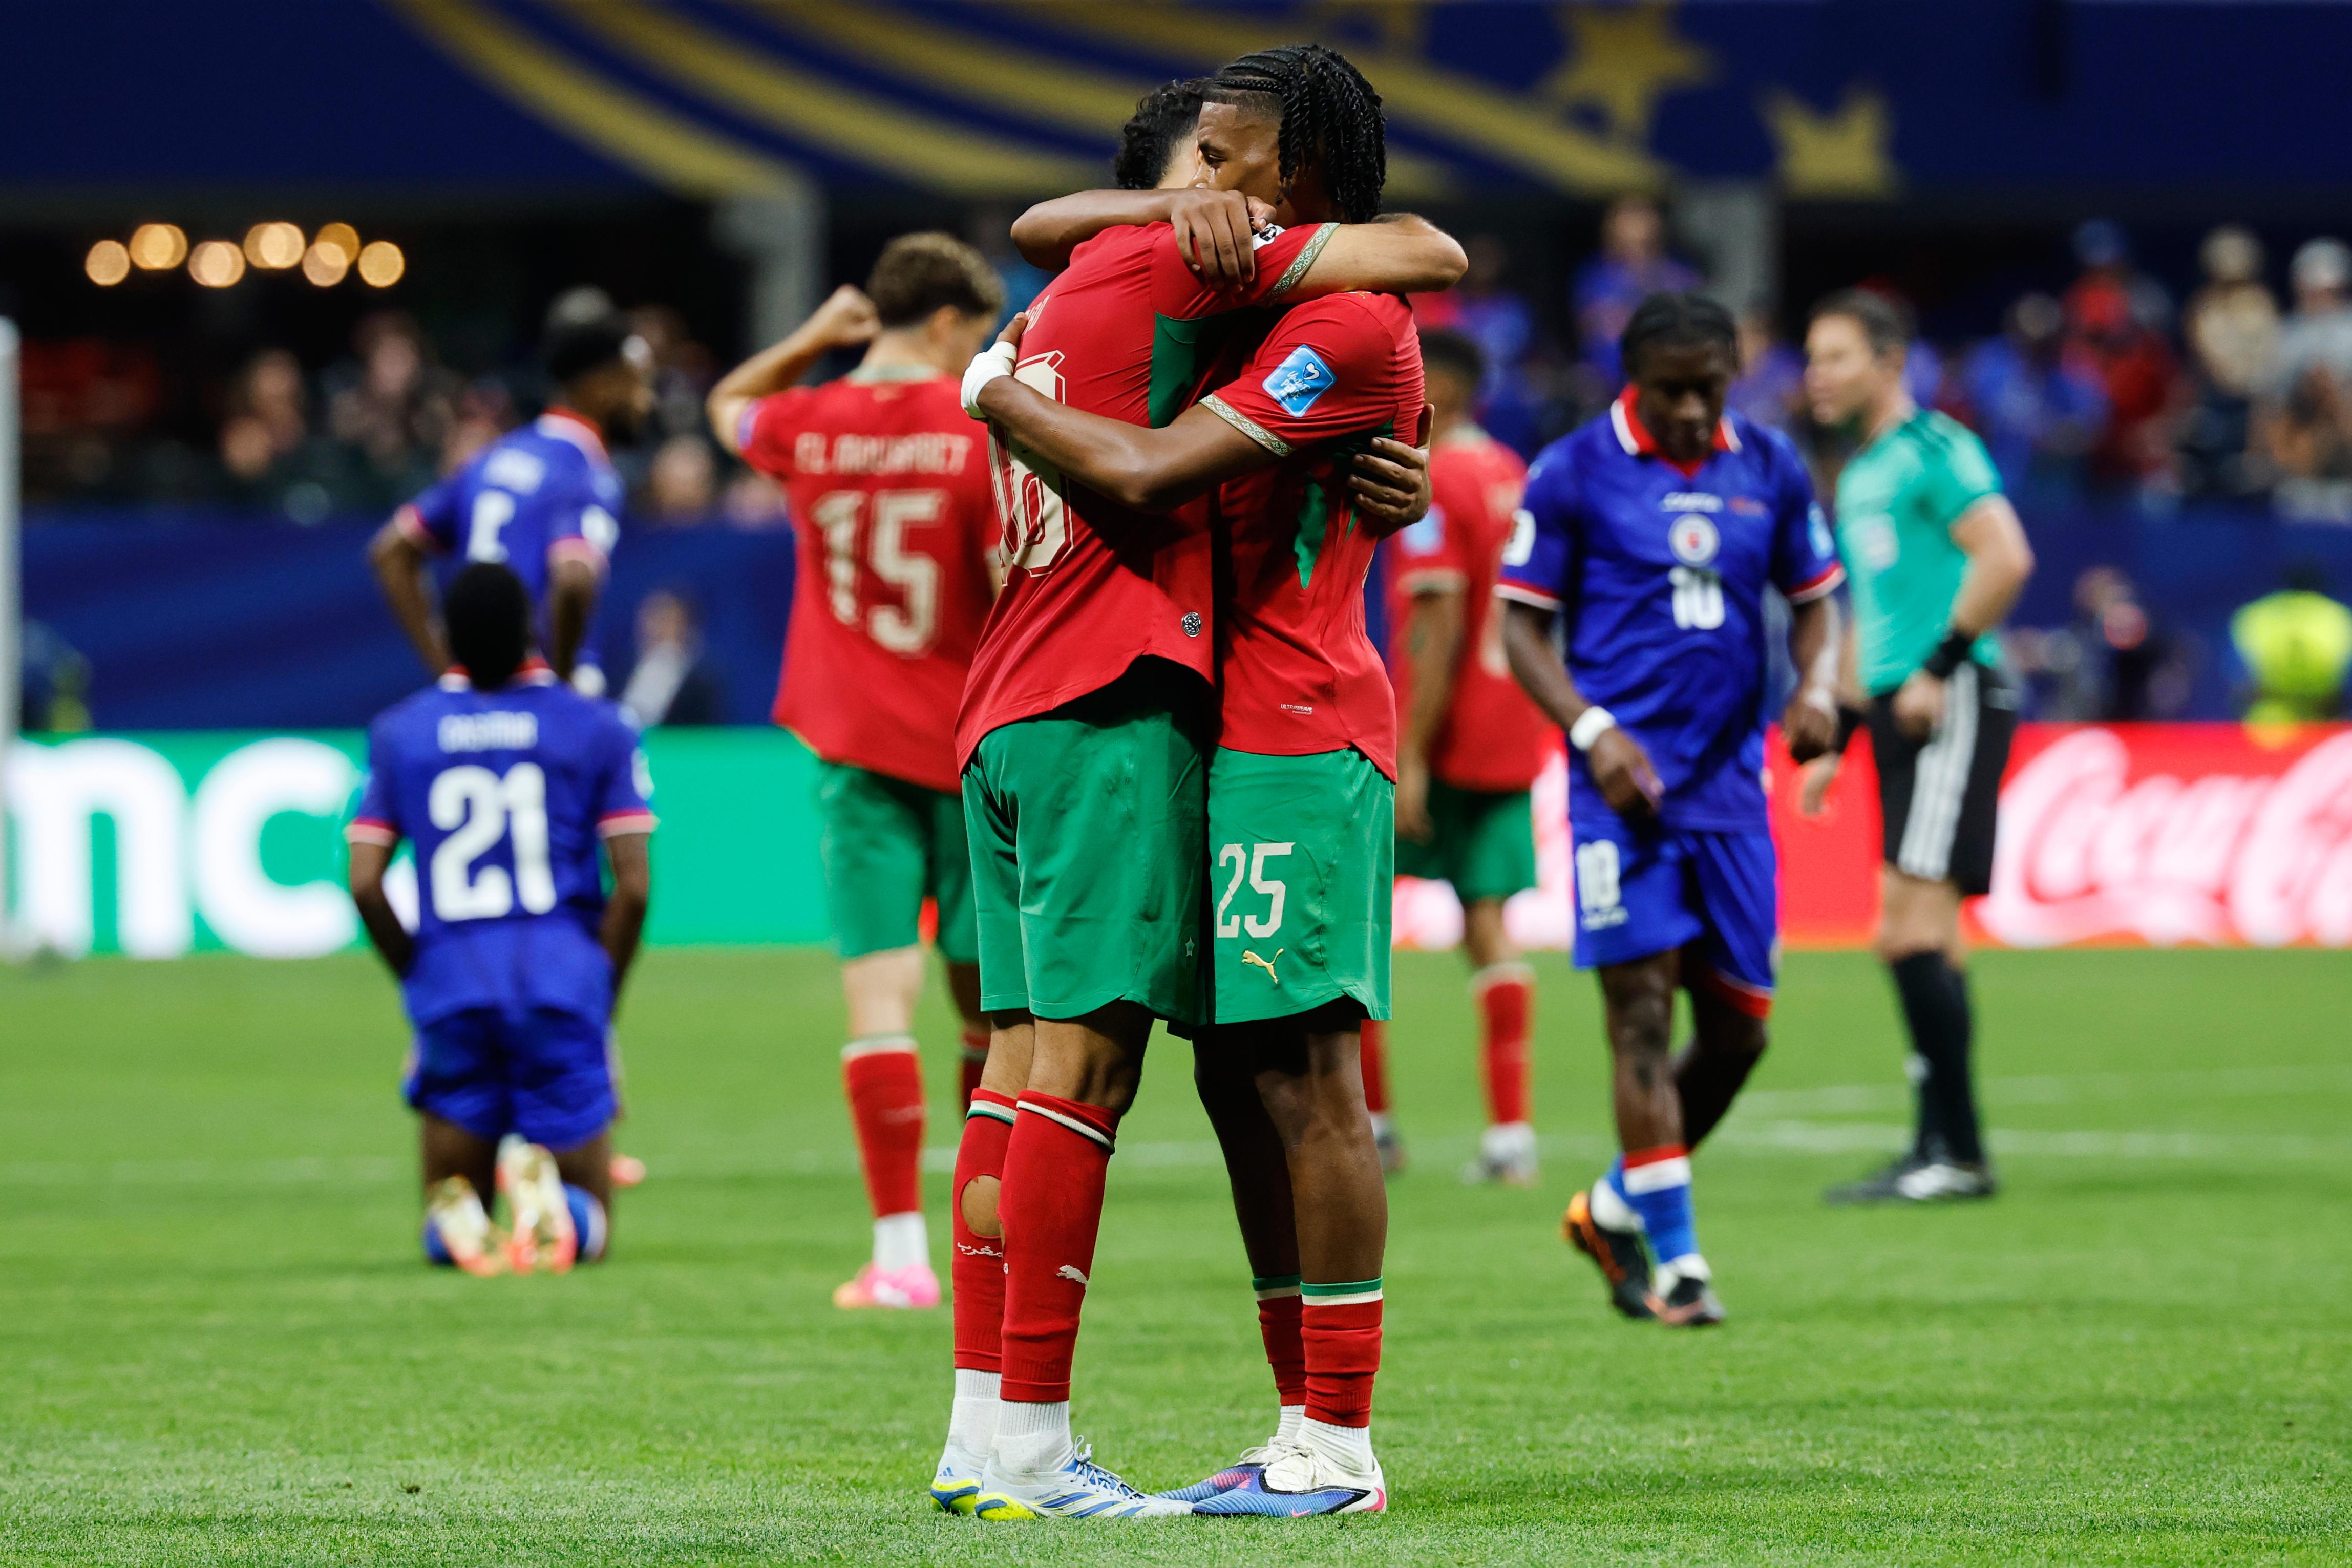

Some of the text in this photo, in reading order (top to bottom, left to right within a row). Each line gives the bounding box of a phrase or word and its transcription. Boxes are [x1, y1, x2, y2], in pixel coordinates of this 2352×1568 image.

[811, 488, 946, 655] 15
[428, 762, 557, 923] 21
[1217, 842, 1296, 938] 25
